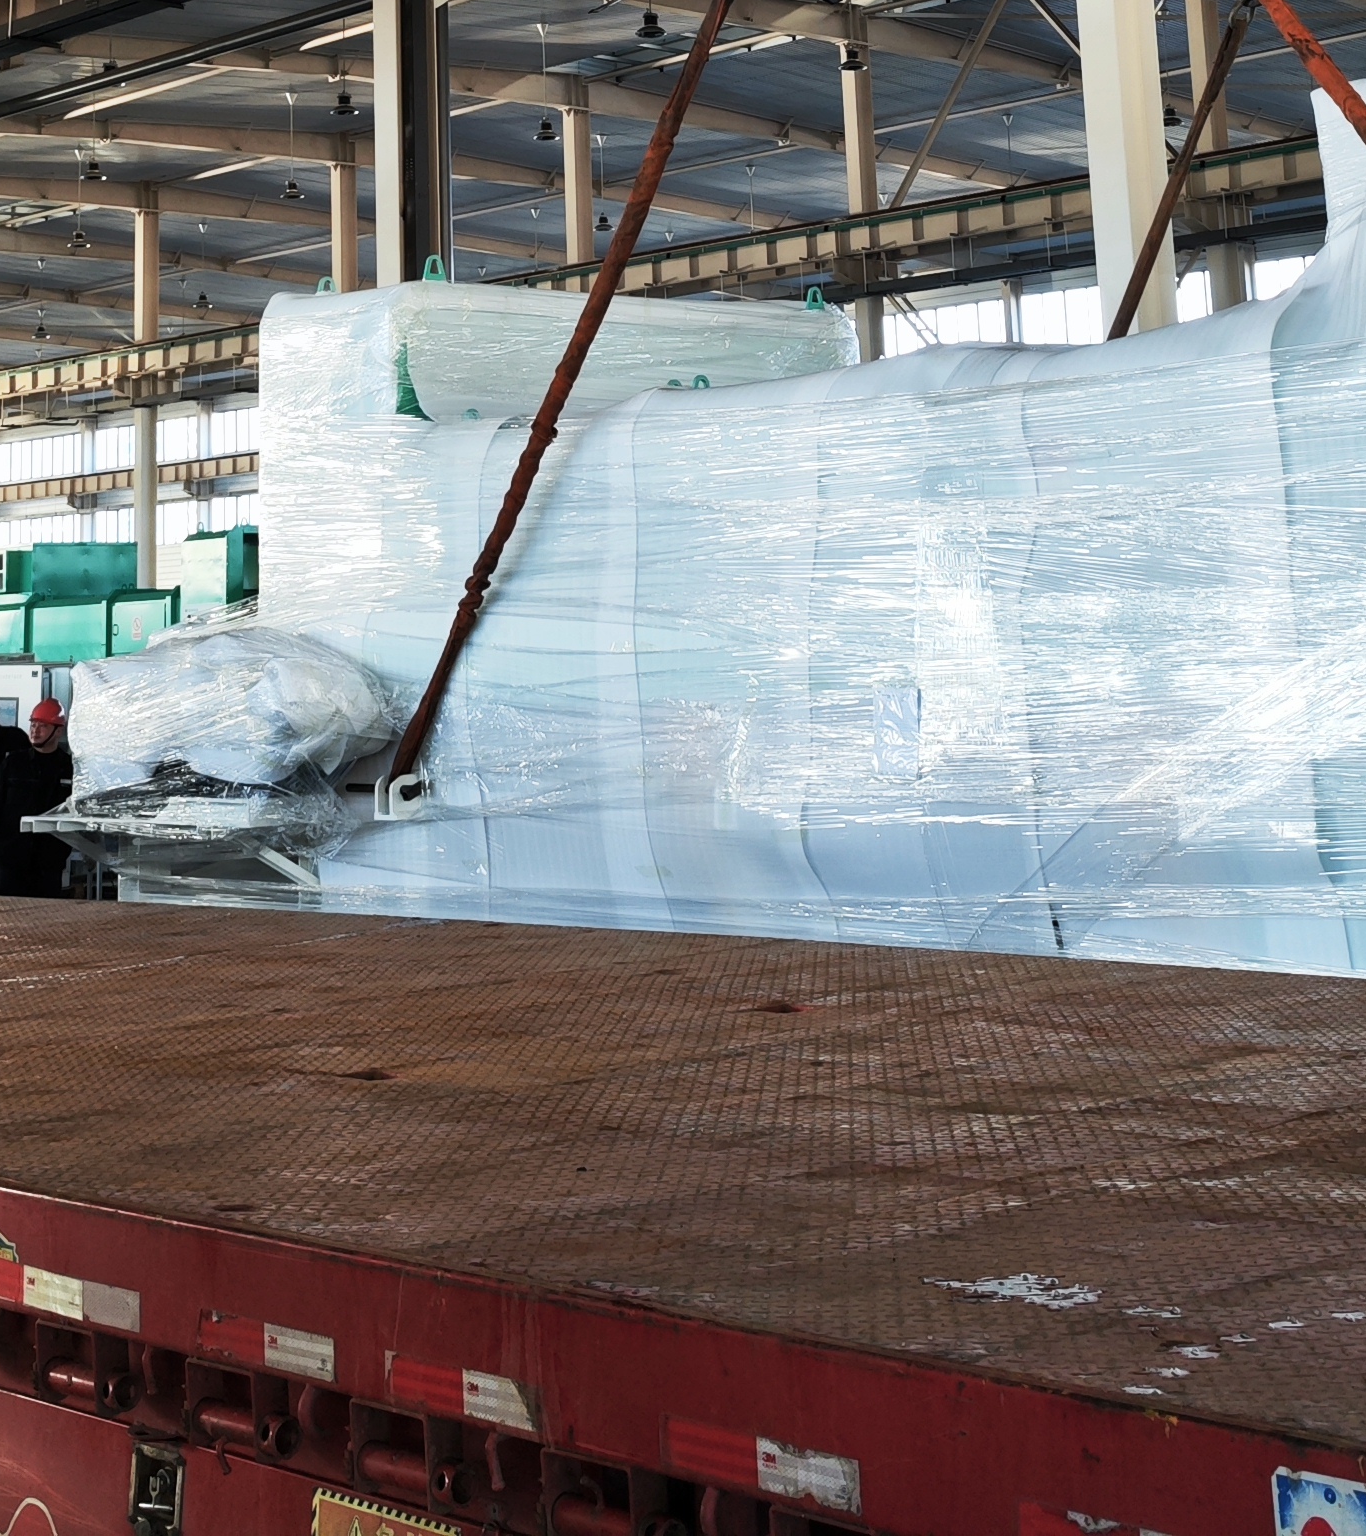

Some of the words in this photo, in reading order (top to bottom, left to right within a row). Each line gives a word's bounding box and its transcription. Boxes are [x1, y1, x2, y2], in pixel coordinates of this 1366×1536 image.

[267, 1334, 278, 1344] 3M
[466, 1381, 480, 1393] 3M
[761, 1451, 777, 1465] 3M
